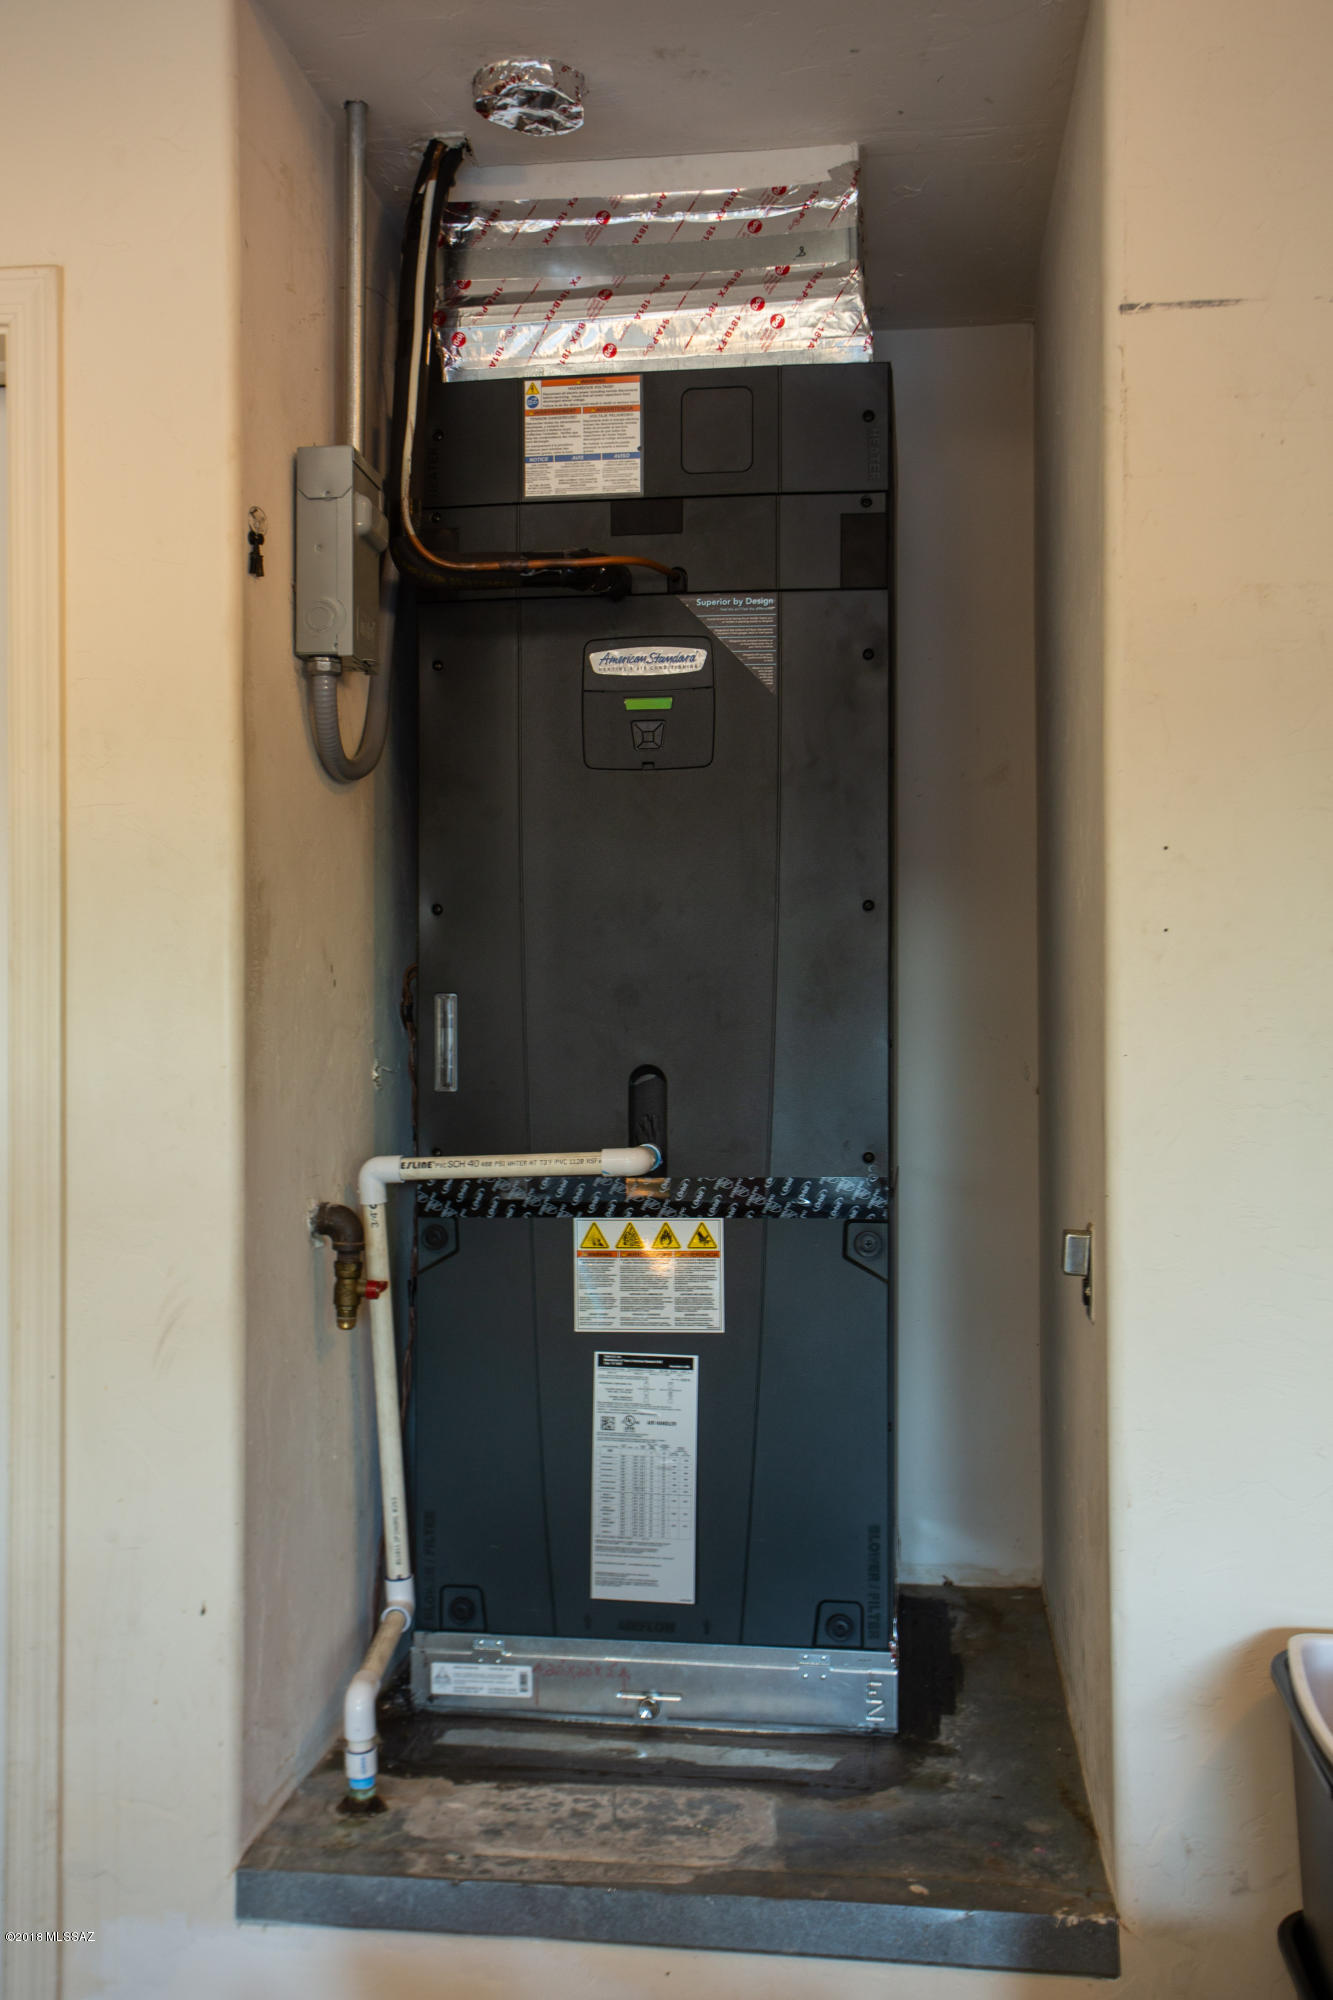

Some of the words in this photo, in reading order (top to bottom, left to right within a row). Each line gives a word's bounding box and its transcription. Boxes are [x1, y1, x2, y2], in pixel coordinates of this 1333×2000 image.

[696, 598, 731, 607] Superior
[732, 597, 743, 607] by
[745, 597, 774, 606] Design
[599, 651, 647, 665] American
[646, 650, 698, 665] Standard
